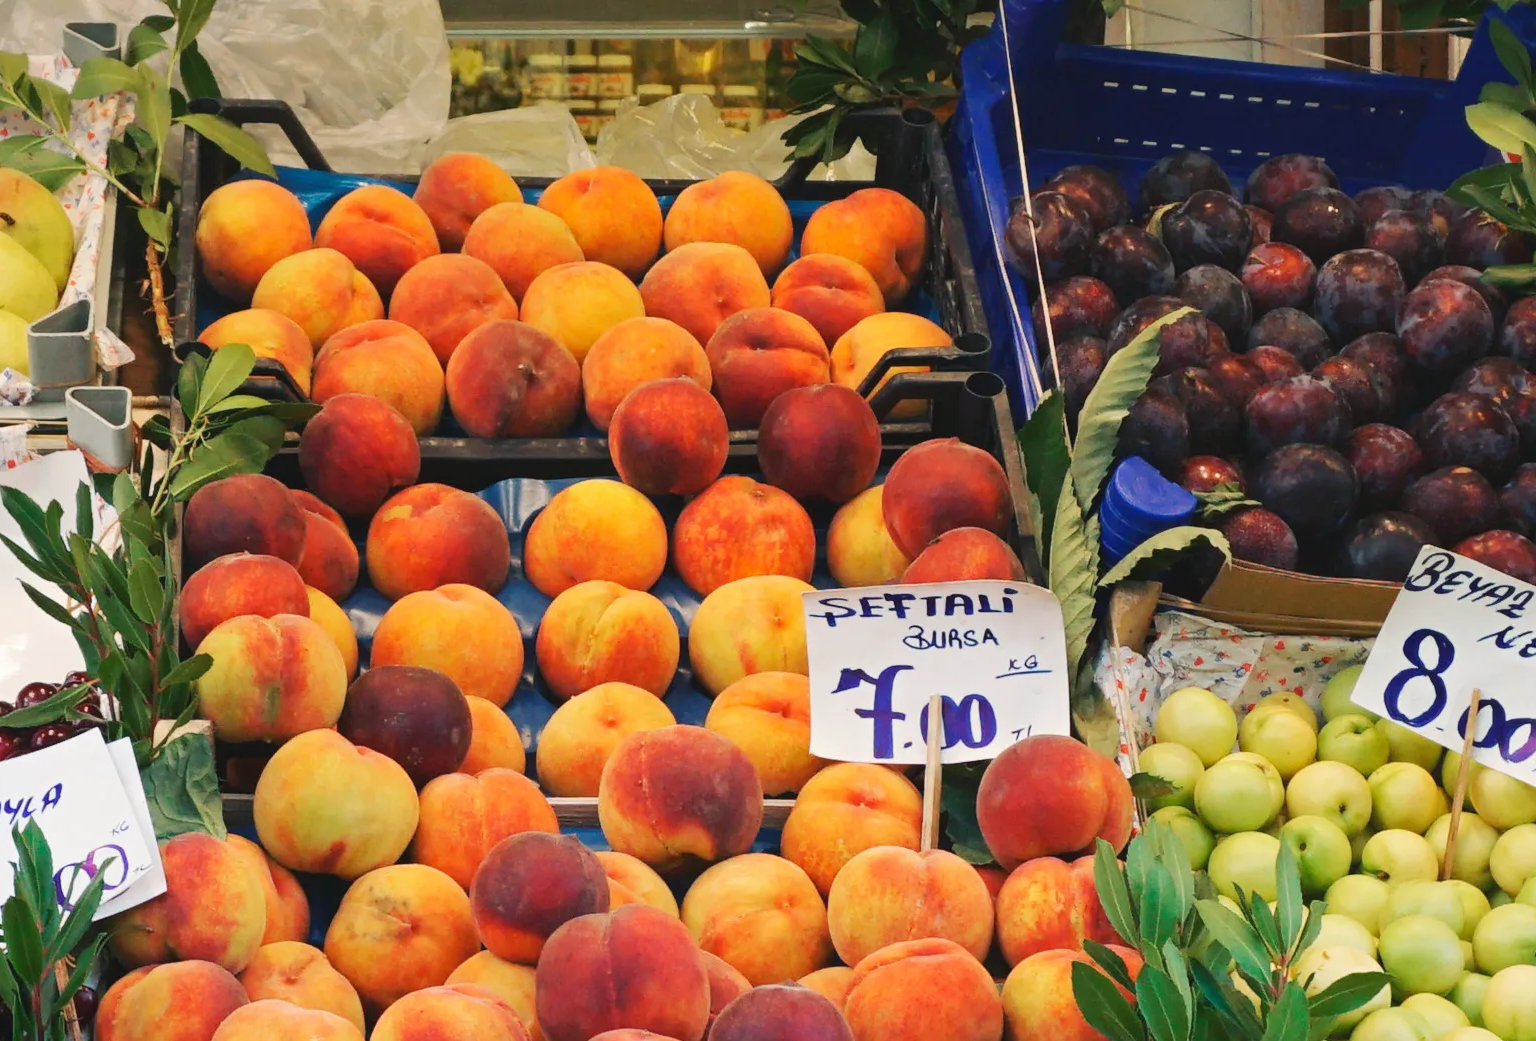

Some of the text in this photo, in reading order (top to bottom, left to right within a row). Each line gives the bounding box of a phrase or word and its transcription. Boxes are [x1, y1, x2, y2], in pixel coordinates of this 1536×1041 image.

[1404, 552, 1535, 619] BEYAZ
[809, 588, 1019, 627] ŞEFTALİ
[902, 625, 999, 650] BURSA
[1008, 655, 1038, 670] KG
